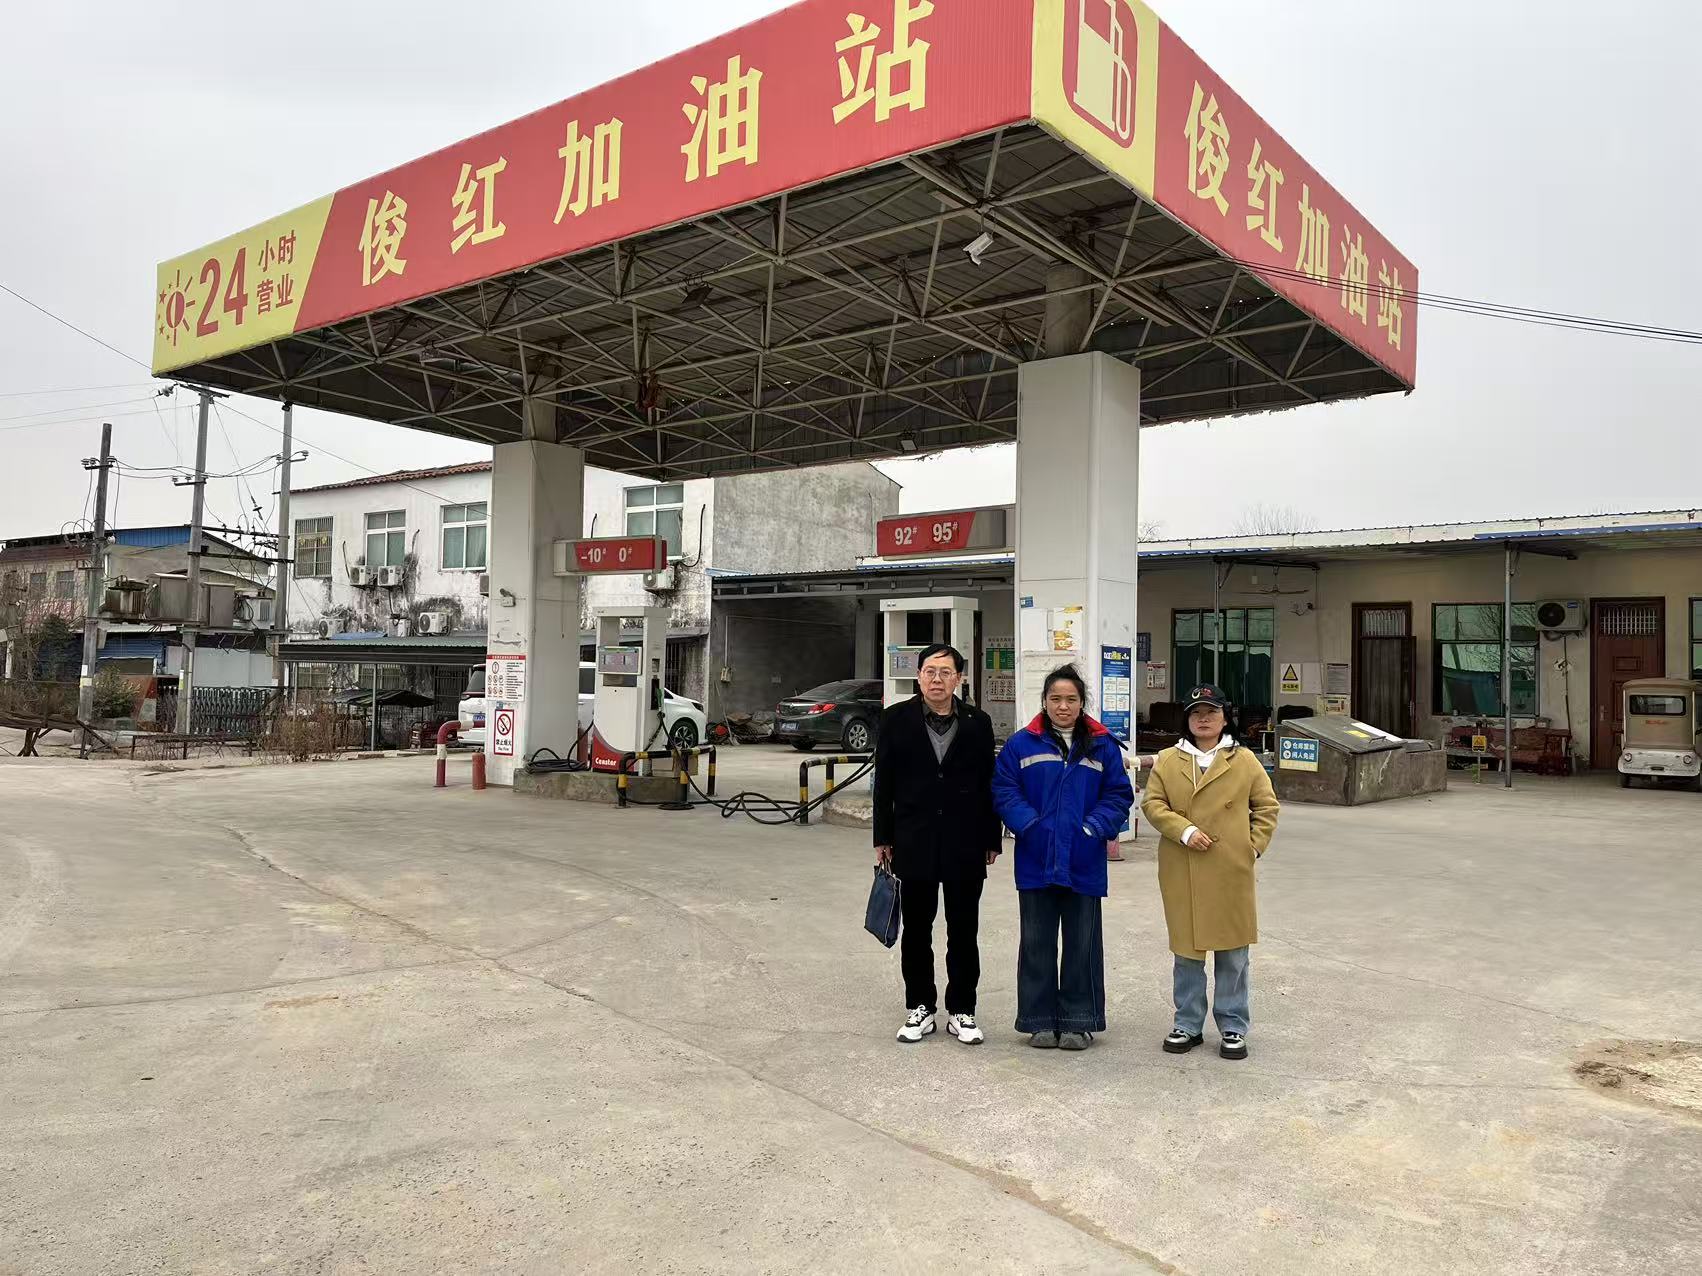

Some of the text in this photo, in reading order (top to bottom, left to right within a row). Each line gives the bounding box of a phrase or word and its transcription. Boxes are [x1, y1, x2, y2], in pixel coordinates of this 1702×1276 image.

[360, 0, 935, 286] 俊红加油站
[1184, 80, 1403, 351] 俊红加油站
[258, 230, 296, 272] 小时
[197, 247, 248, 337] 24
[256, 273, 294, 315] 营业
[932, 521, 958, 542] 95#
